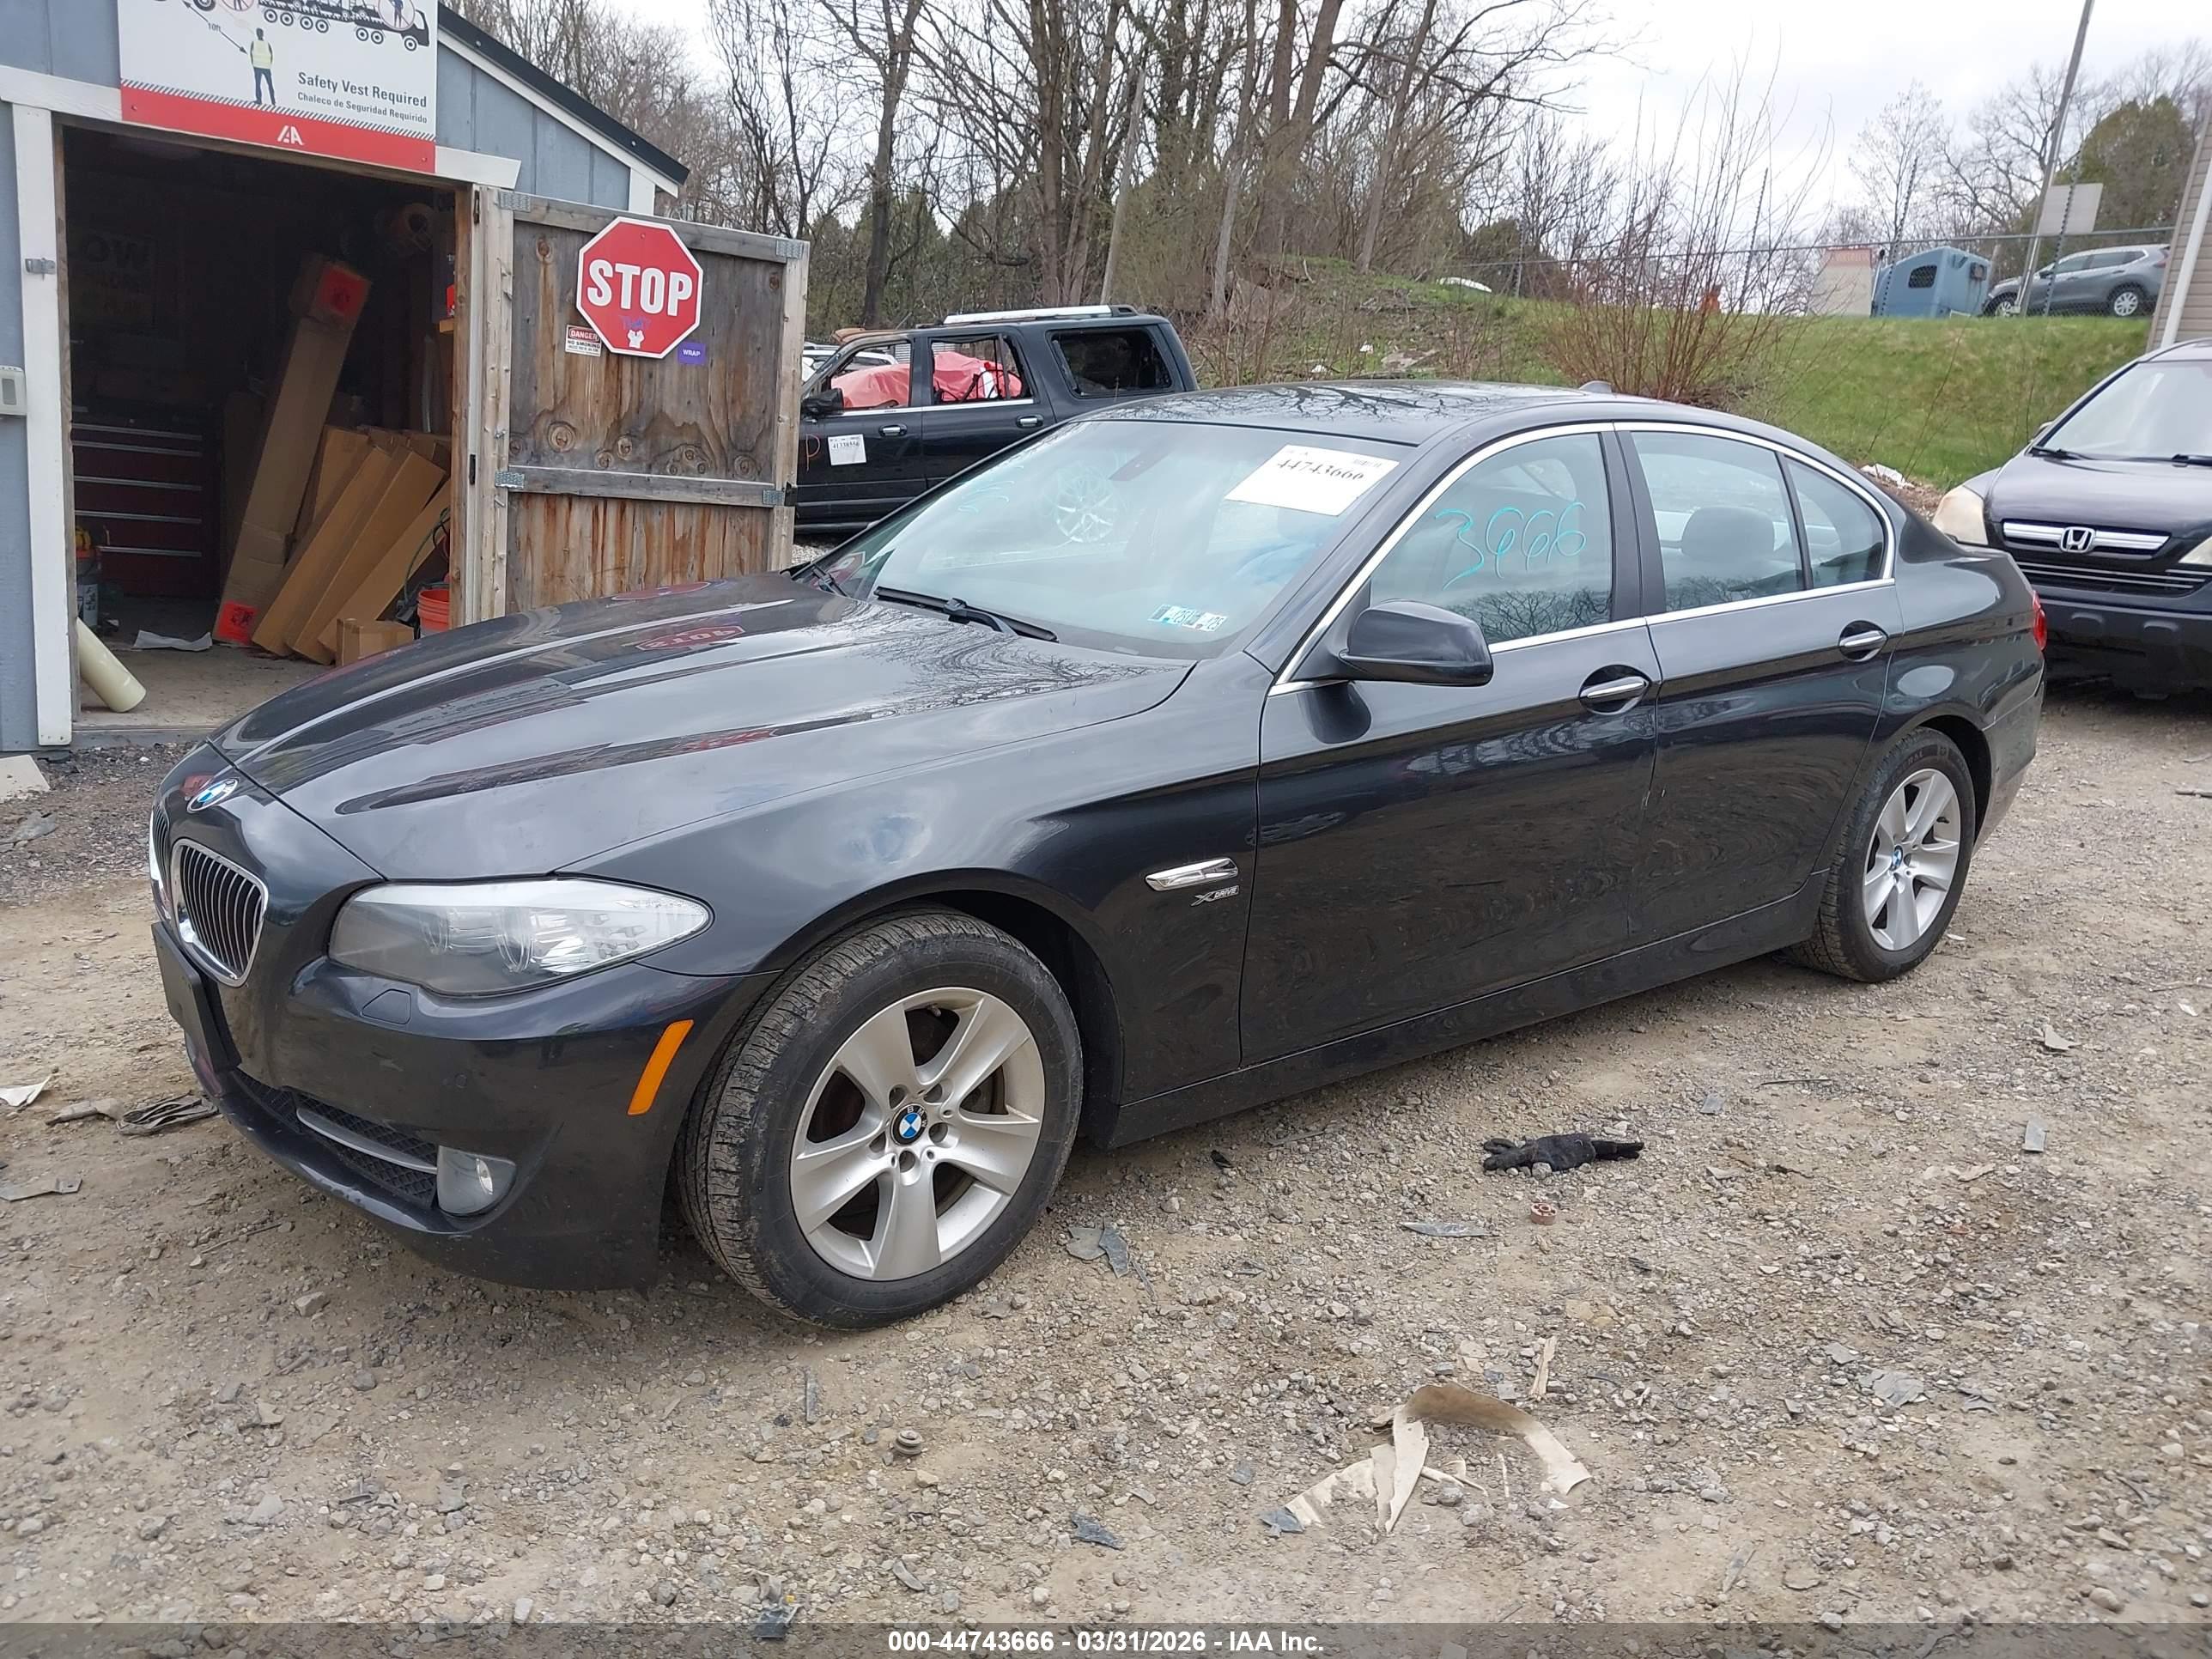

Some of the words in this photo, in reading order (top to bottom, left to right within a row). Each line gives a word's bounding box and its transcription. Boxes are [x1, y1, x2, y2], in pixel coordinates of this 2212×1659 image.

[298, 72, 338, 93] Safety
[342, 80, 368, 97] Vest
[372, 86, 428, 107] Required
[298, 92, 331, 106] Chaleco
[334, 99, 343, 108] de
[346, 100, 387, 116] Seguridad
[389, 108, 428, 124] Requirido
[587, 258, 693, 317] STOP
[570, 330, 599, 341] DANGER
[683, 349, 701, 357] WRAP
[1434, 501, 1587, 591] 3666
